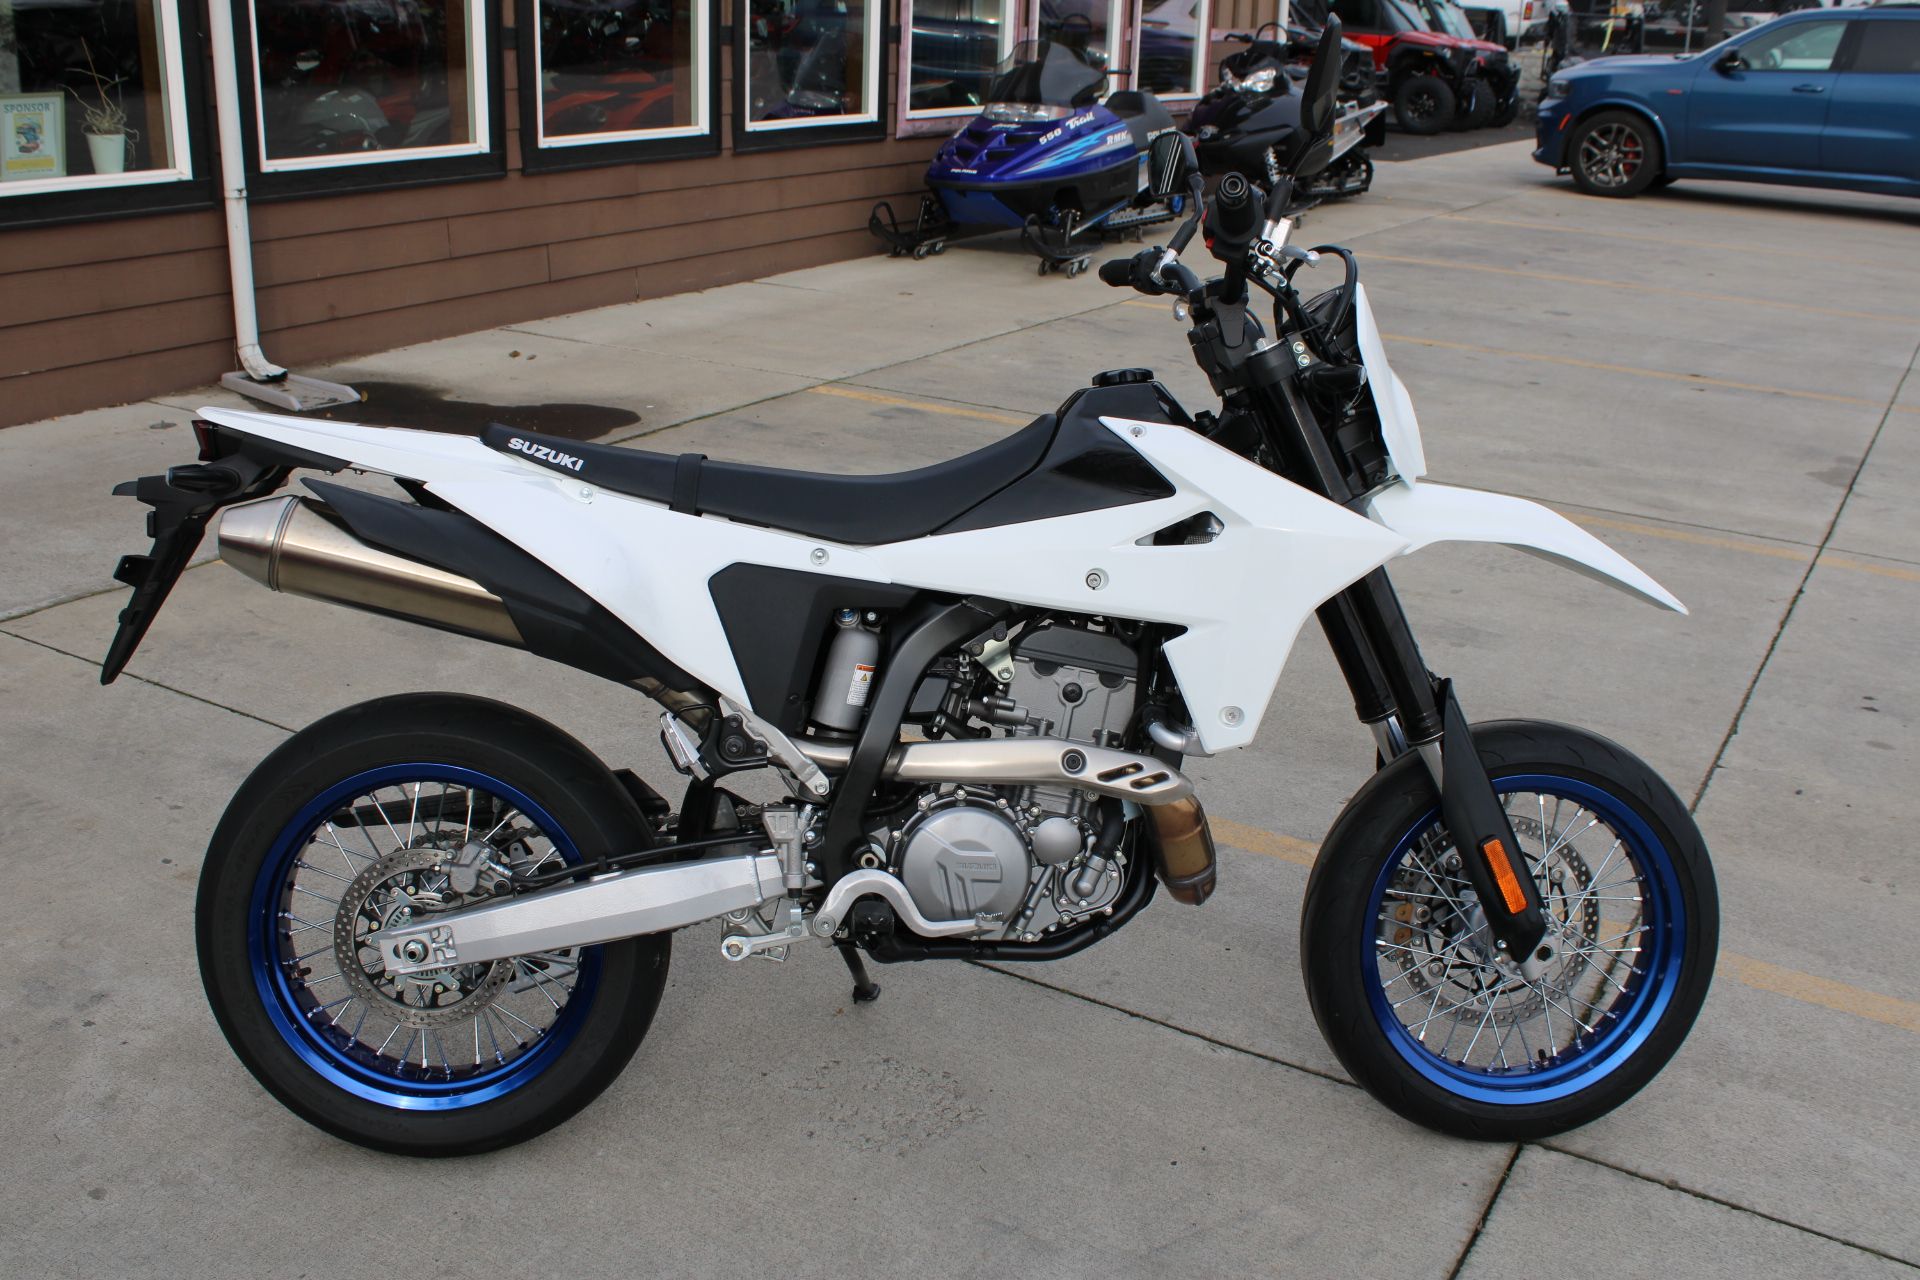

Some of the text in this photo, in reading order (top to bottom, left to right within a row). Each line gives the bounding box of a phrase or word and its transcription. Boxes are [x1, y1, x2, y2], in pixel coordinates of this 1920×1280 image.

[3, 103, 51, 113] SPONSOR
[1039, 128, 1062, 145] 550
[1106, 130, 1128, 145] RMK
[507, 437, 584, 472] SUZUKI
